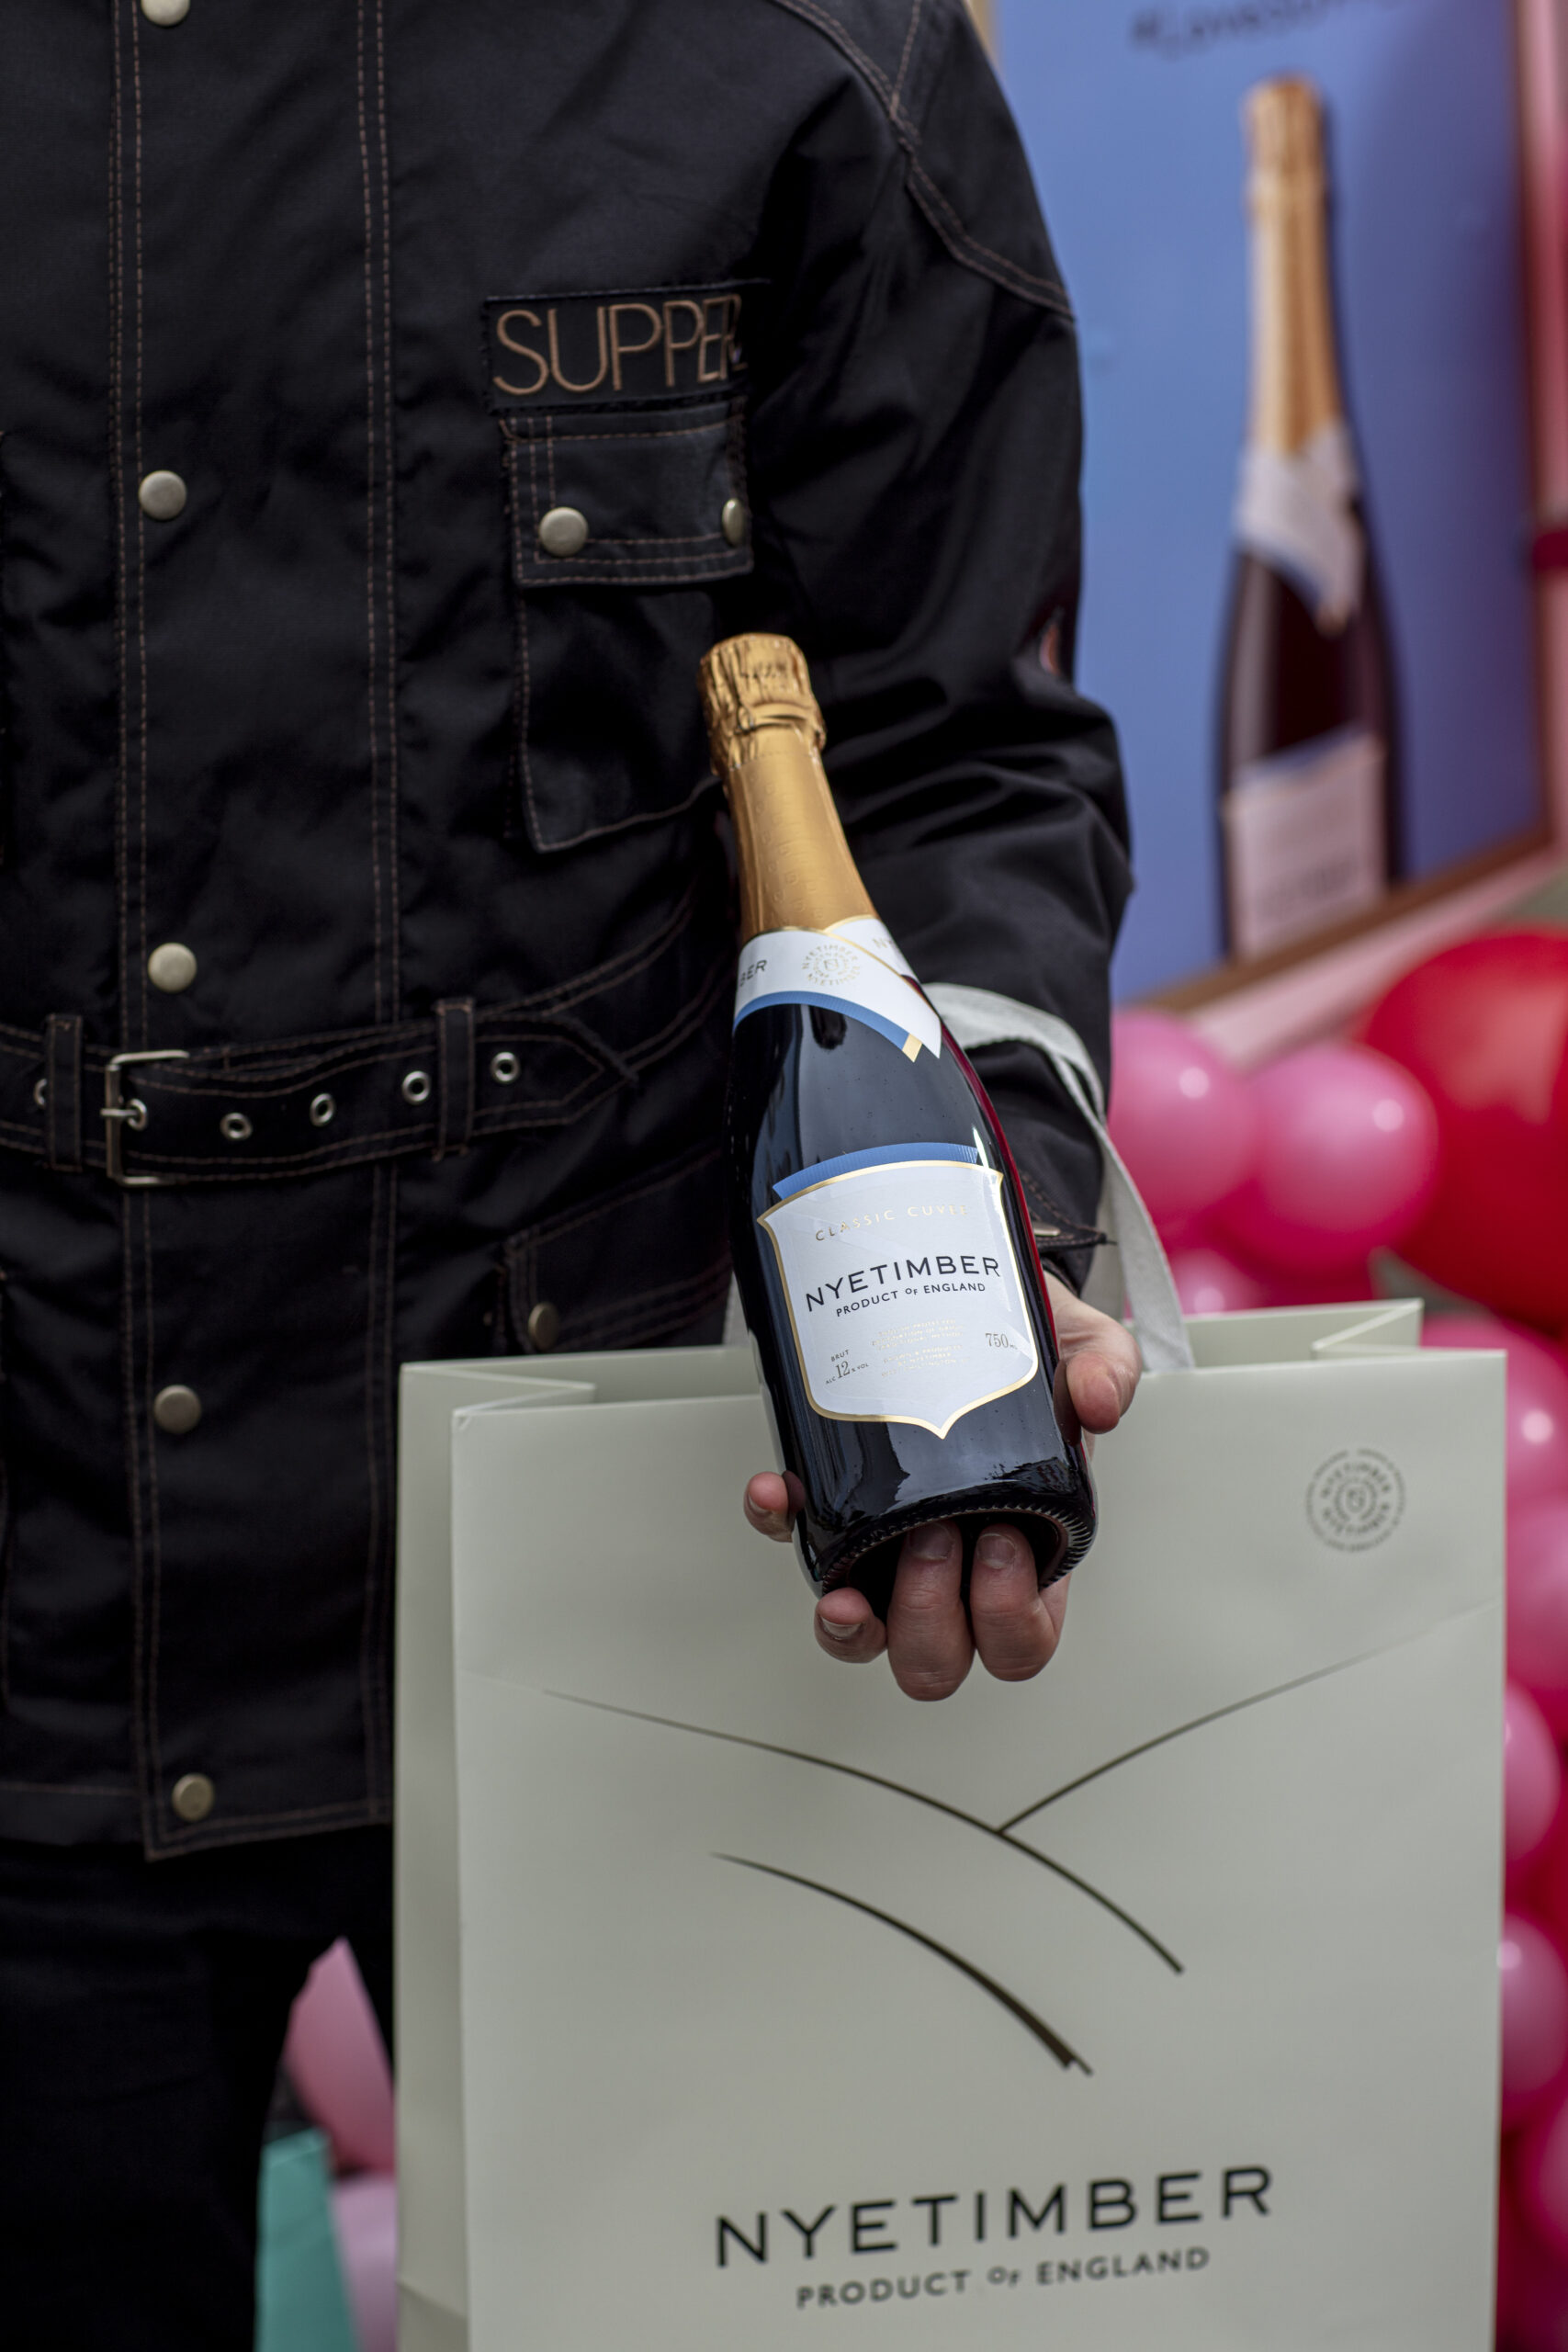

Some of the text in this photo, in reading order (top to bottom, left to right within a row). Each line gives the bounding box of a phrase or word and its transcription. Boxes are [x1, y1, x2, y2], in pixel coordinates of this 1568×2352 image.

[493, 294, 748, 395] SUPPER
[815, 1209, 896, 1241] CLASSIC
[806, 1255, 1000, 1312] NYETIMBER
[836, 1290, 898, 1317] PRODUCT
[923, 1283, 986, 1294] ENGLAND
[830, 1349, 850, 1362] BRUT
[716, 2165, 1272, 2267] NYETIMBER
[796, 2269, 970, 2309] PRODUCT
[1036, 2246, 1210, 2286] ENGLAND
